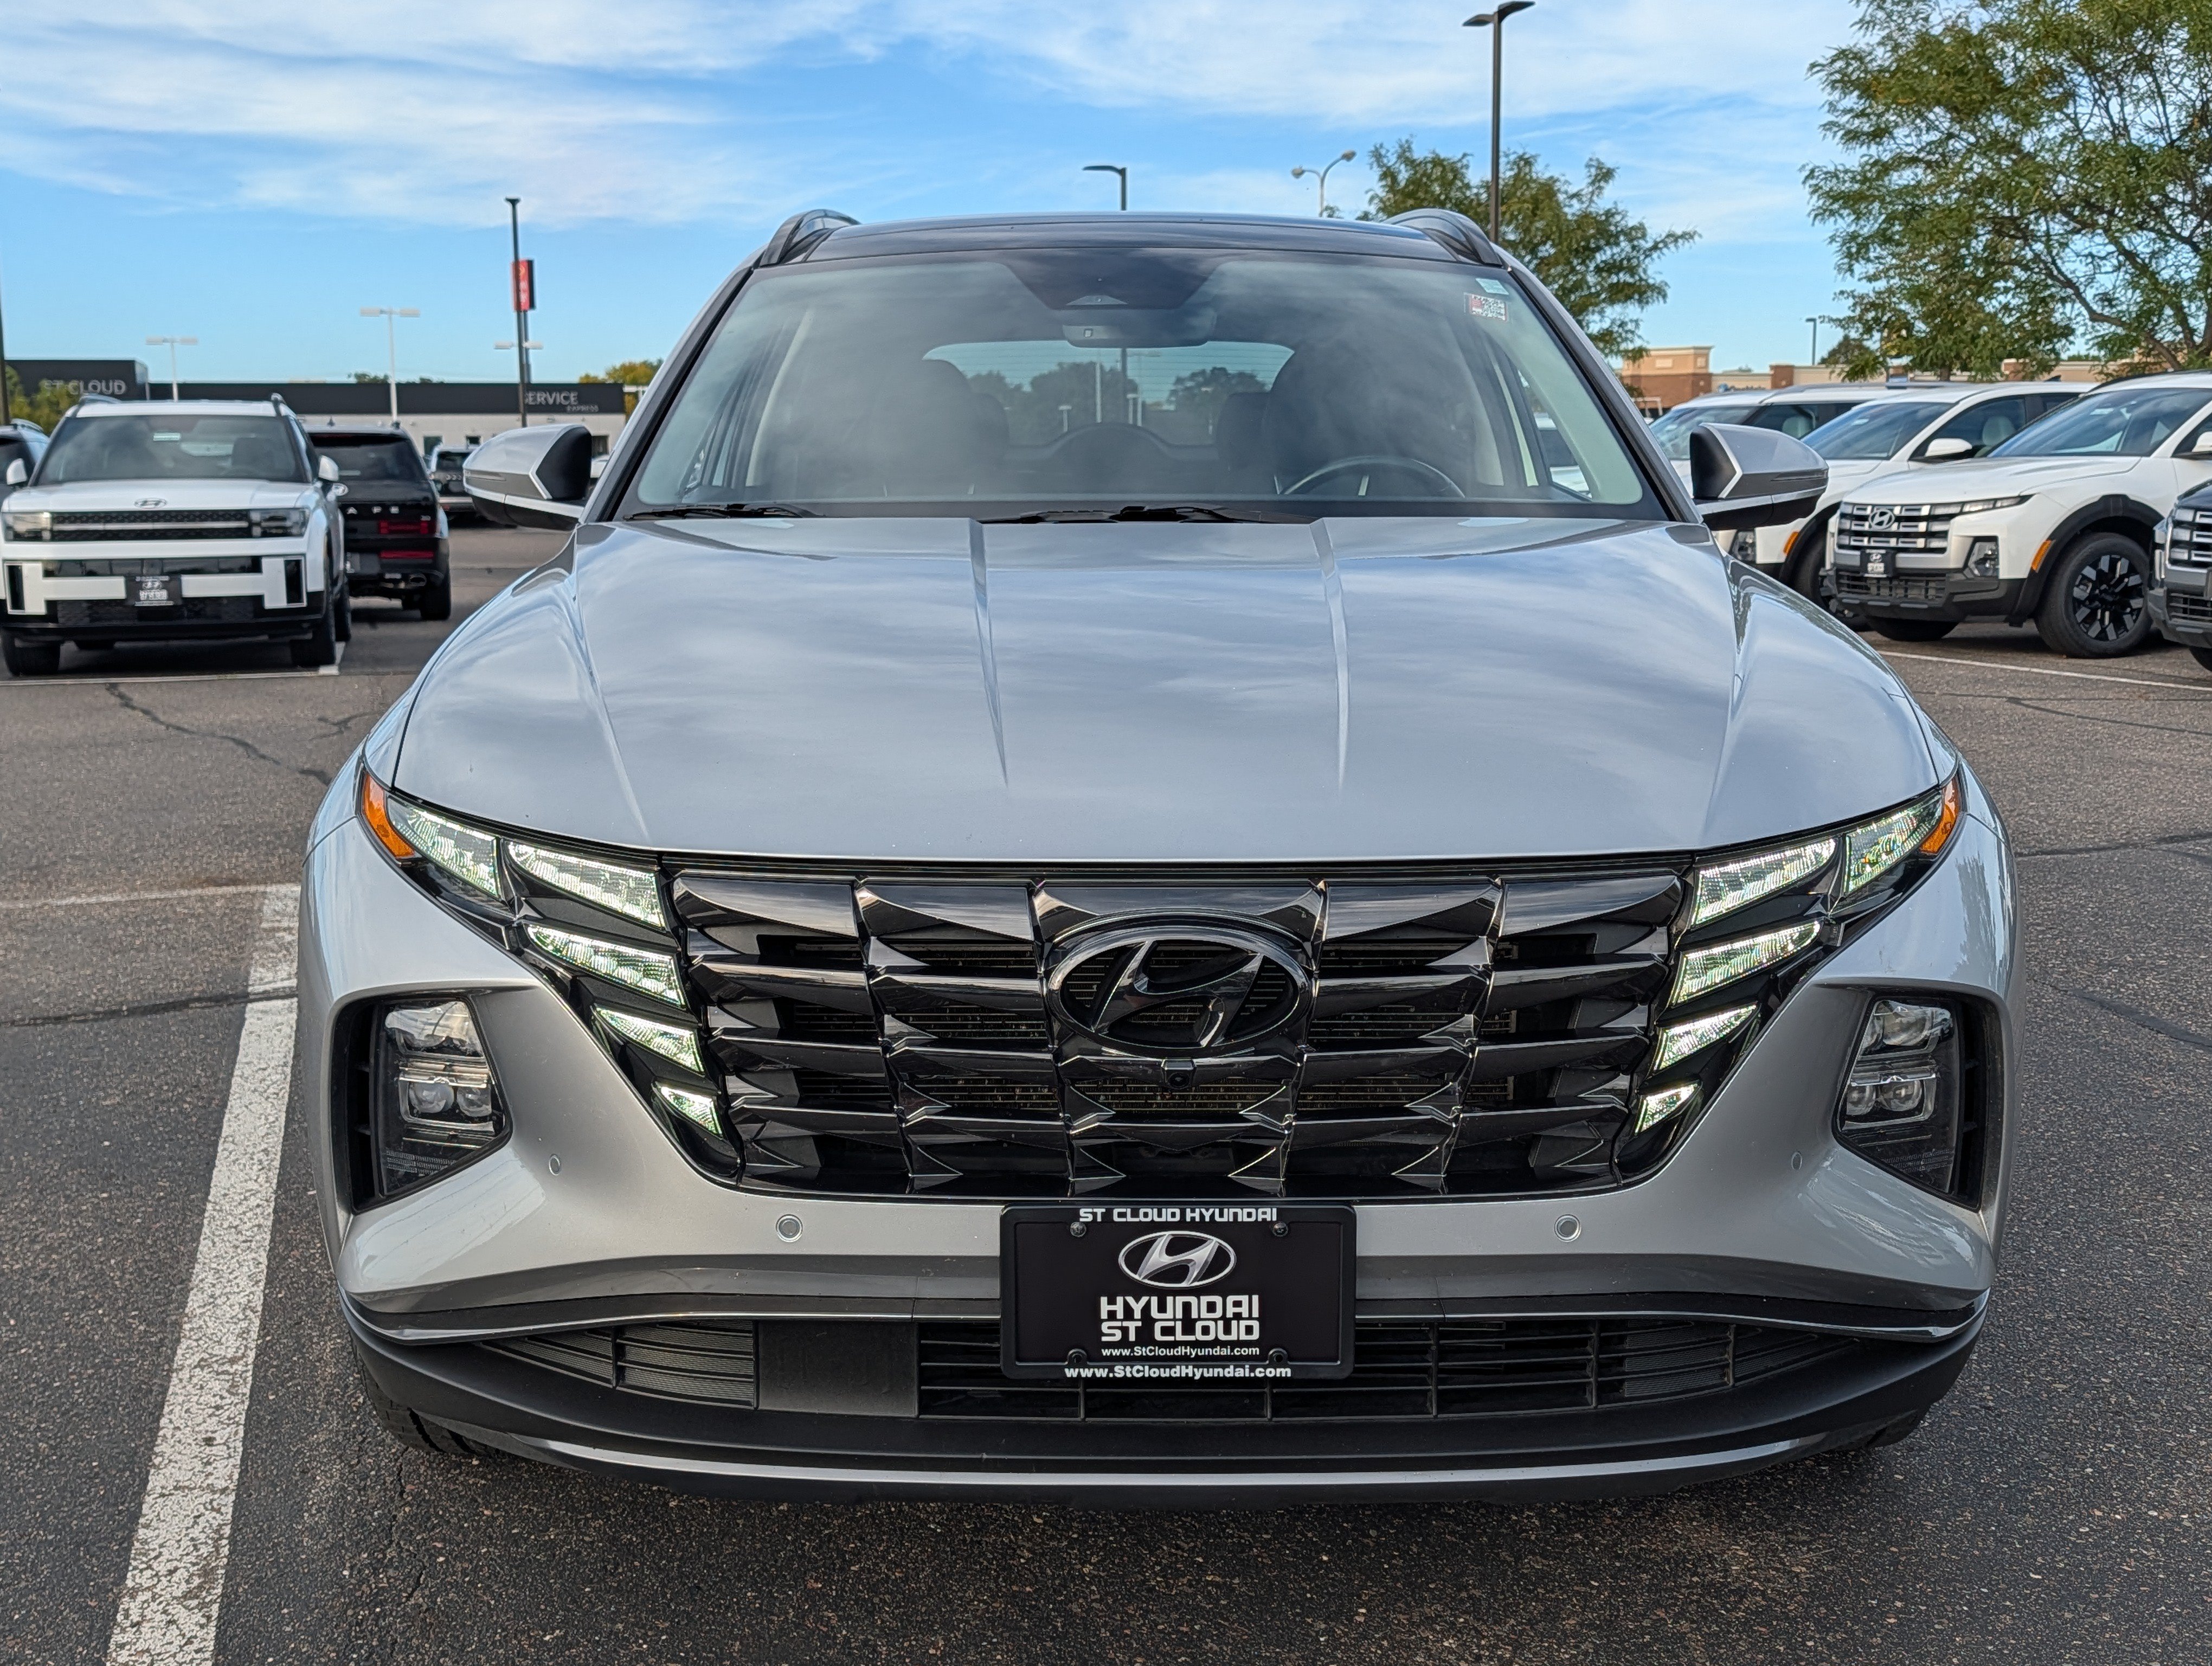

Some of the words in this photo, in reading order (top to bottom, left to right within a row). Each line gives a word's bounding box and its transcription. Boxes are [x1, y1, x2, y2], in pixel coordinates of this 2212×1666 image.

[69, 380, 126, 395] CLOUD
[1079, 1208, 1106, 1222] ST
[1113, 1208, 1180, 1222] CLOUD
[1186, 1207, 1277, 1222] HYUNDAI
[1101, 1295, 1259, 1319] HYUNDAI
[1101, 1321, 1141, 1342] ST
[1154, 1320, 1259, 1342] CLOUD
[1101, 1345, 1259, 1358] www.StCloudHyundai.com
[1064, 1364, 1292, 1380] www.StCloudHyundai.com
